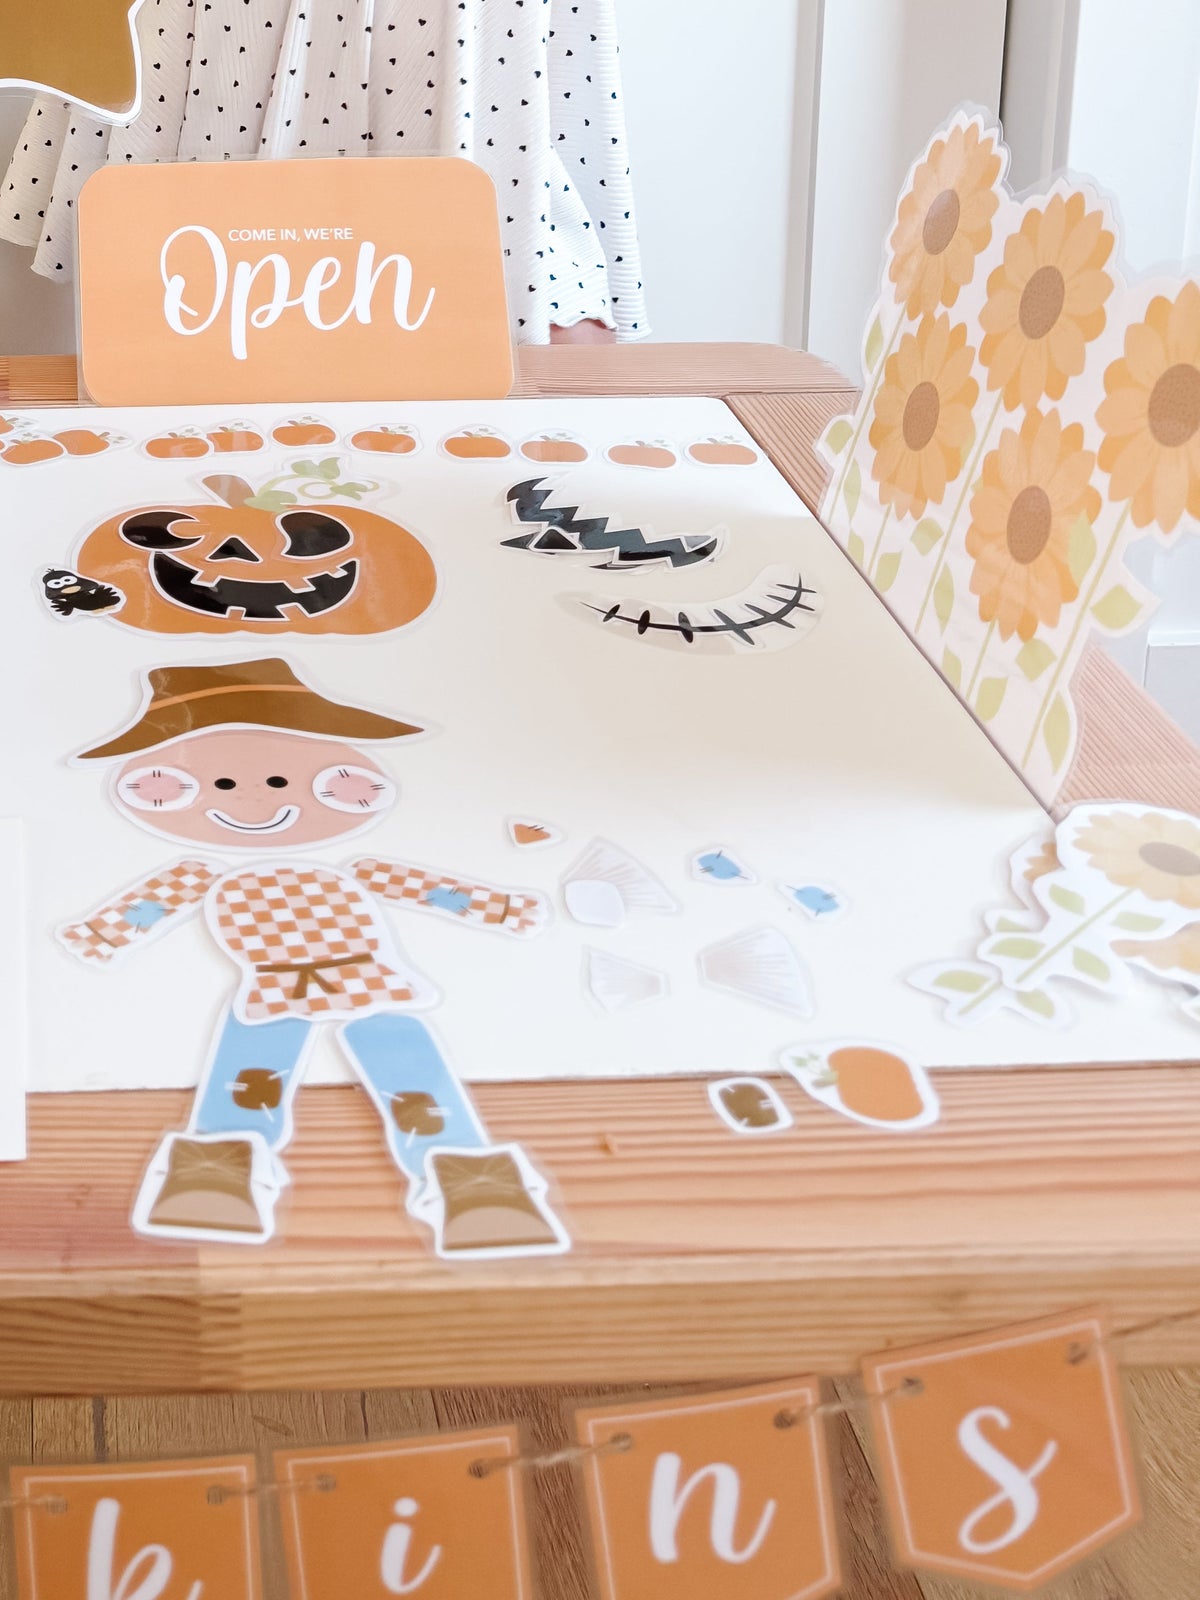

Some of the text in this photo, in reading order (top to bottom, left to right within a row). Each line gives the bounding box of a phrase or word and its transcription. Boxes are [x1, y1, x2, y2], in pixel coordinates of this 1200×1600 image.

[228, 227, 354, 242] COME IN, WE'RE
[160, 225, 436, 360] Open
